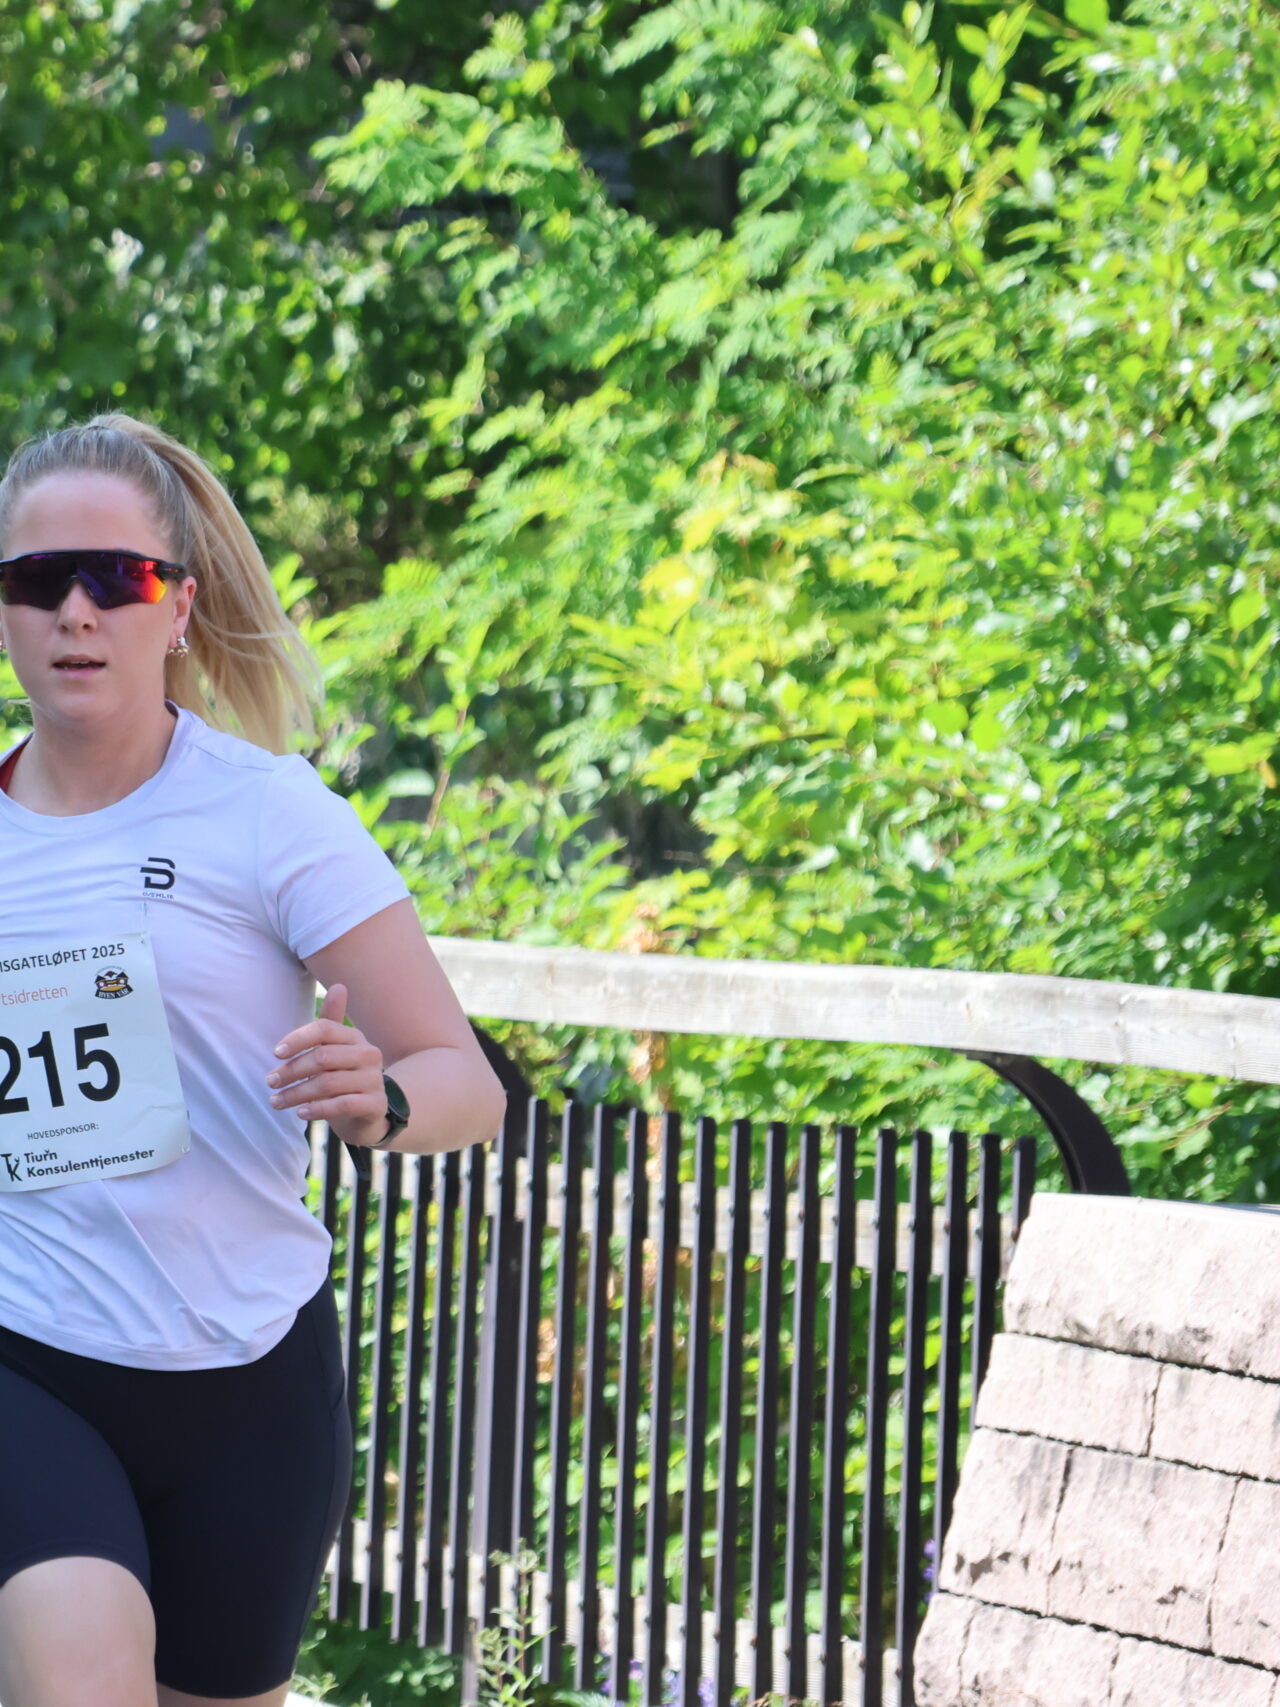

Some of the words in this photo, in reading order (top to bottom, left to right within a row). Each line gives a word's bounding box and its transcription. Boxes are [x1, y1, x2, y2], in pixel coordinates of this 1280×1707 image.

[91, 943, 125, 959] 2025
[27, 1122, 100, 1140] HOVEDSPONSOR:
[26, 1149, 155, 1178] Konsulenttjenester
